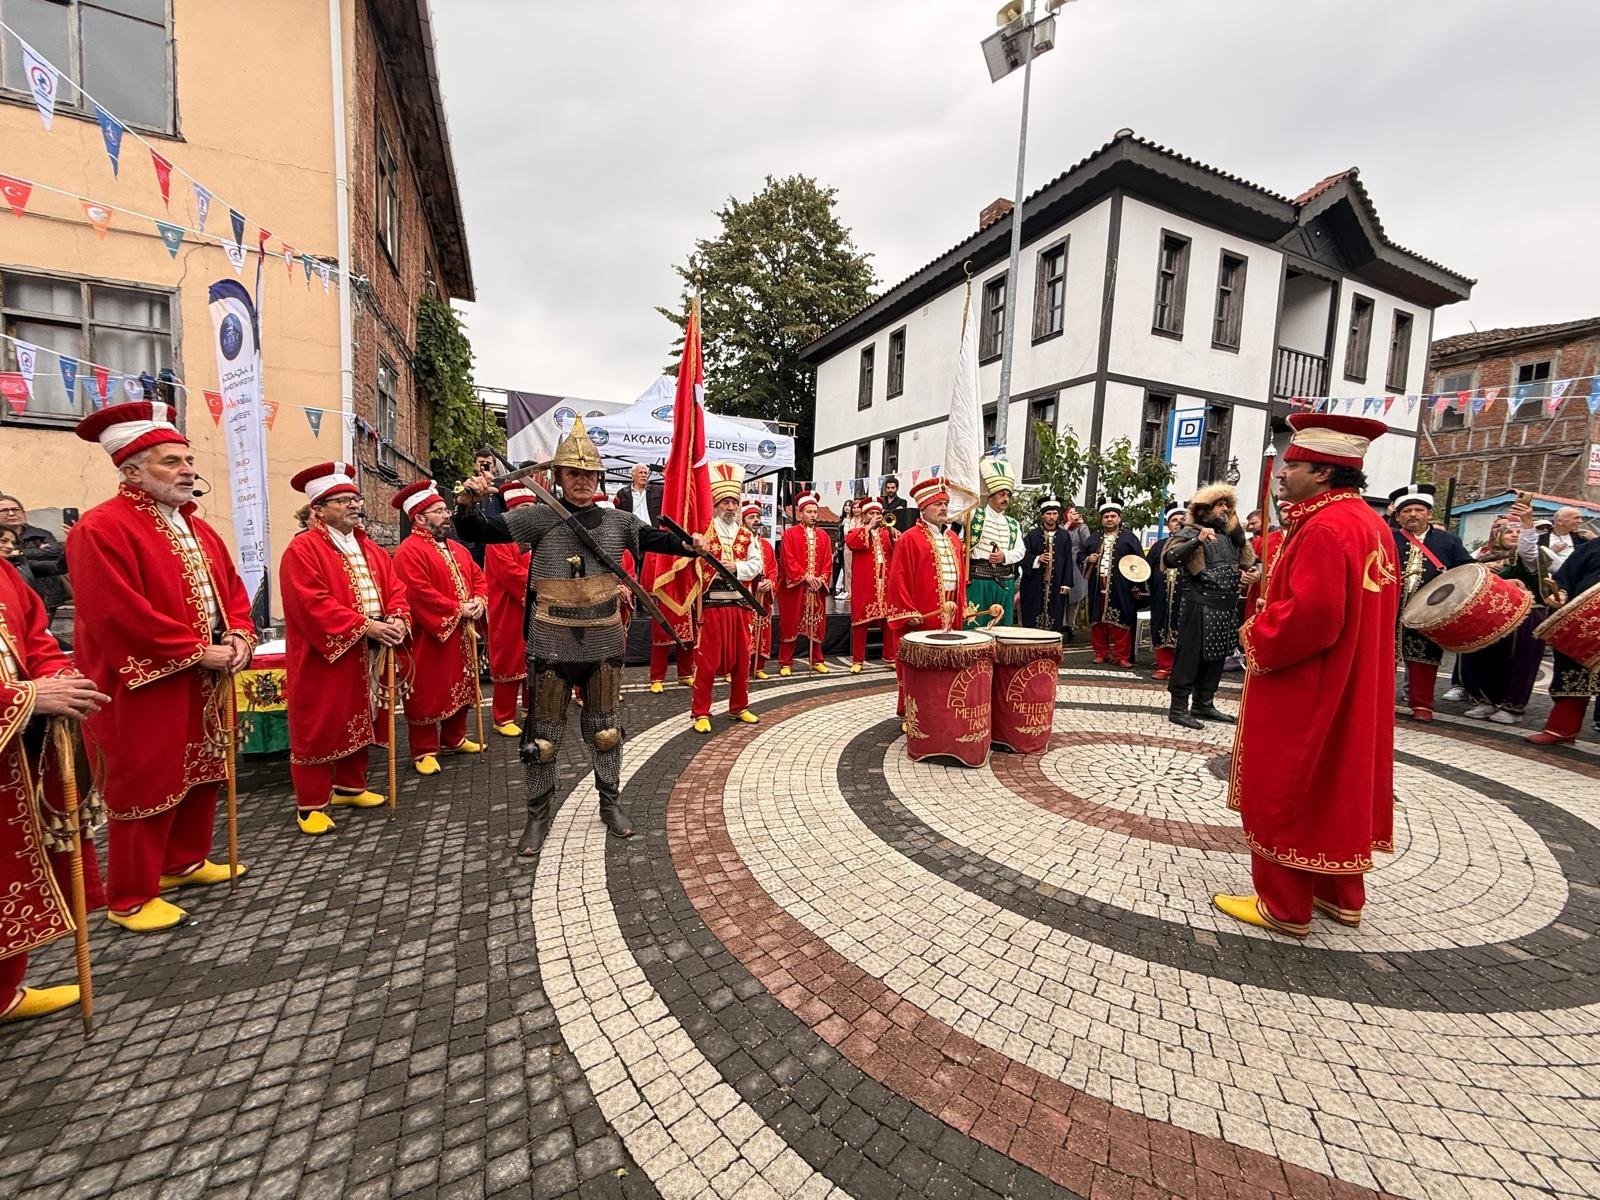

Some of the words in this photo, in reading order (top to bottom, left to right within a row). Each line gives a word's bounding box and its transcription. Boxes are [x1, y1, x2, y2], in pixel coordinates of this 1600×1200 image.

[1185, 423, 1196, 435] D
[623, 433, 672, 446] AKÇAKO
[705, 439, 748, 452] EDİYESİ
